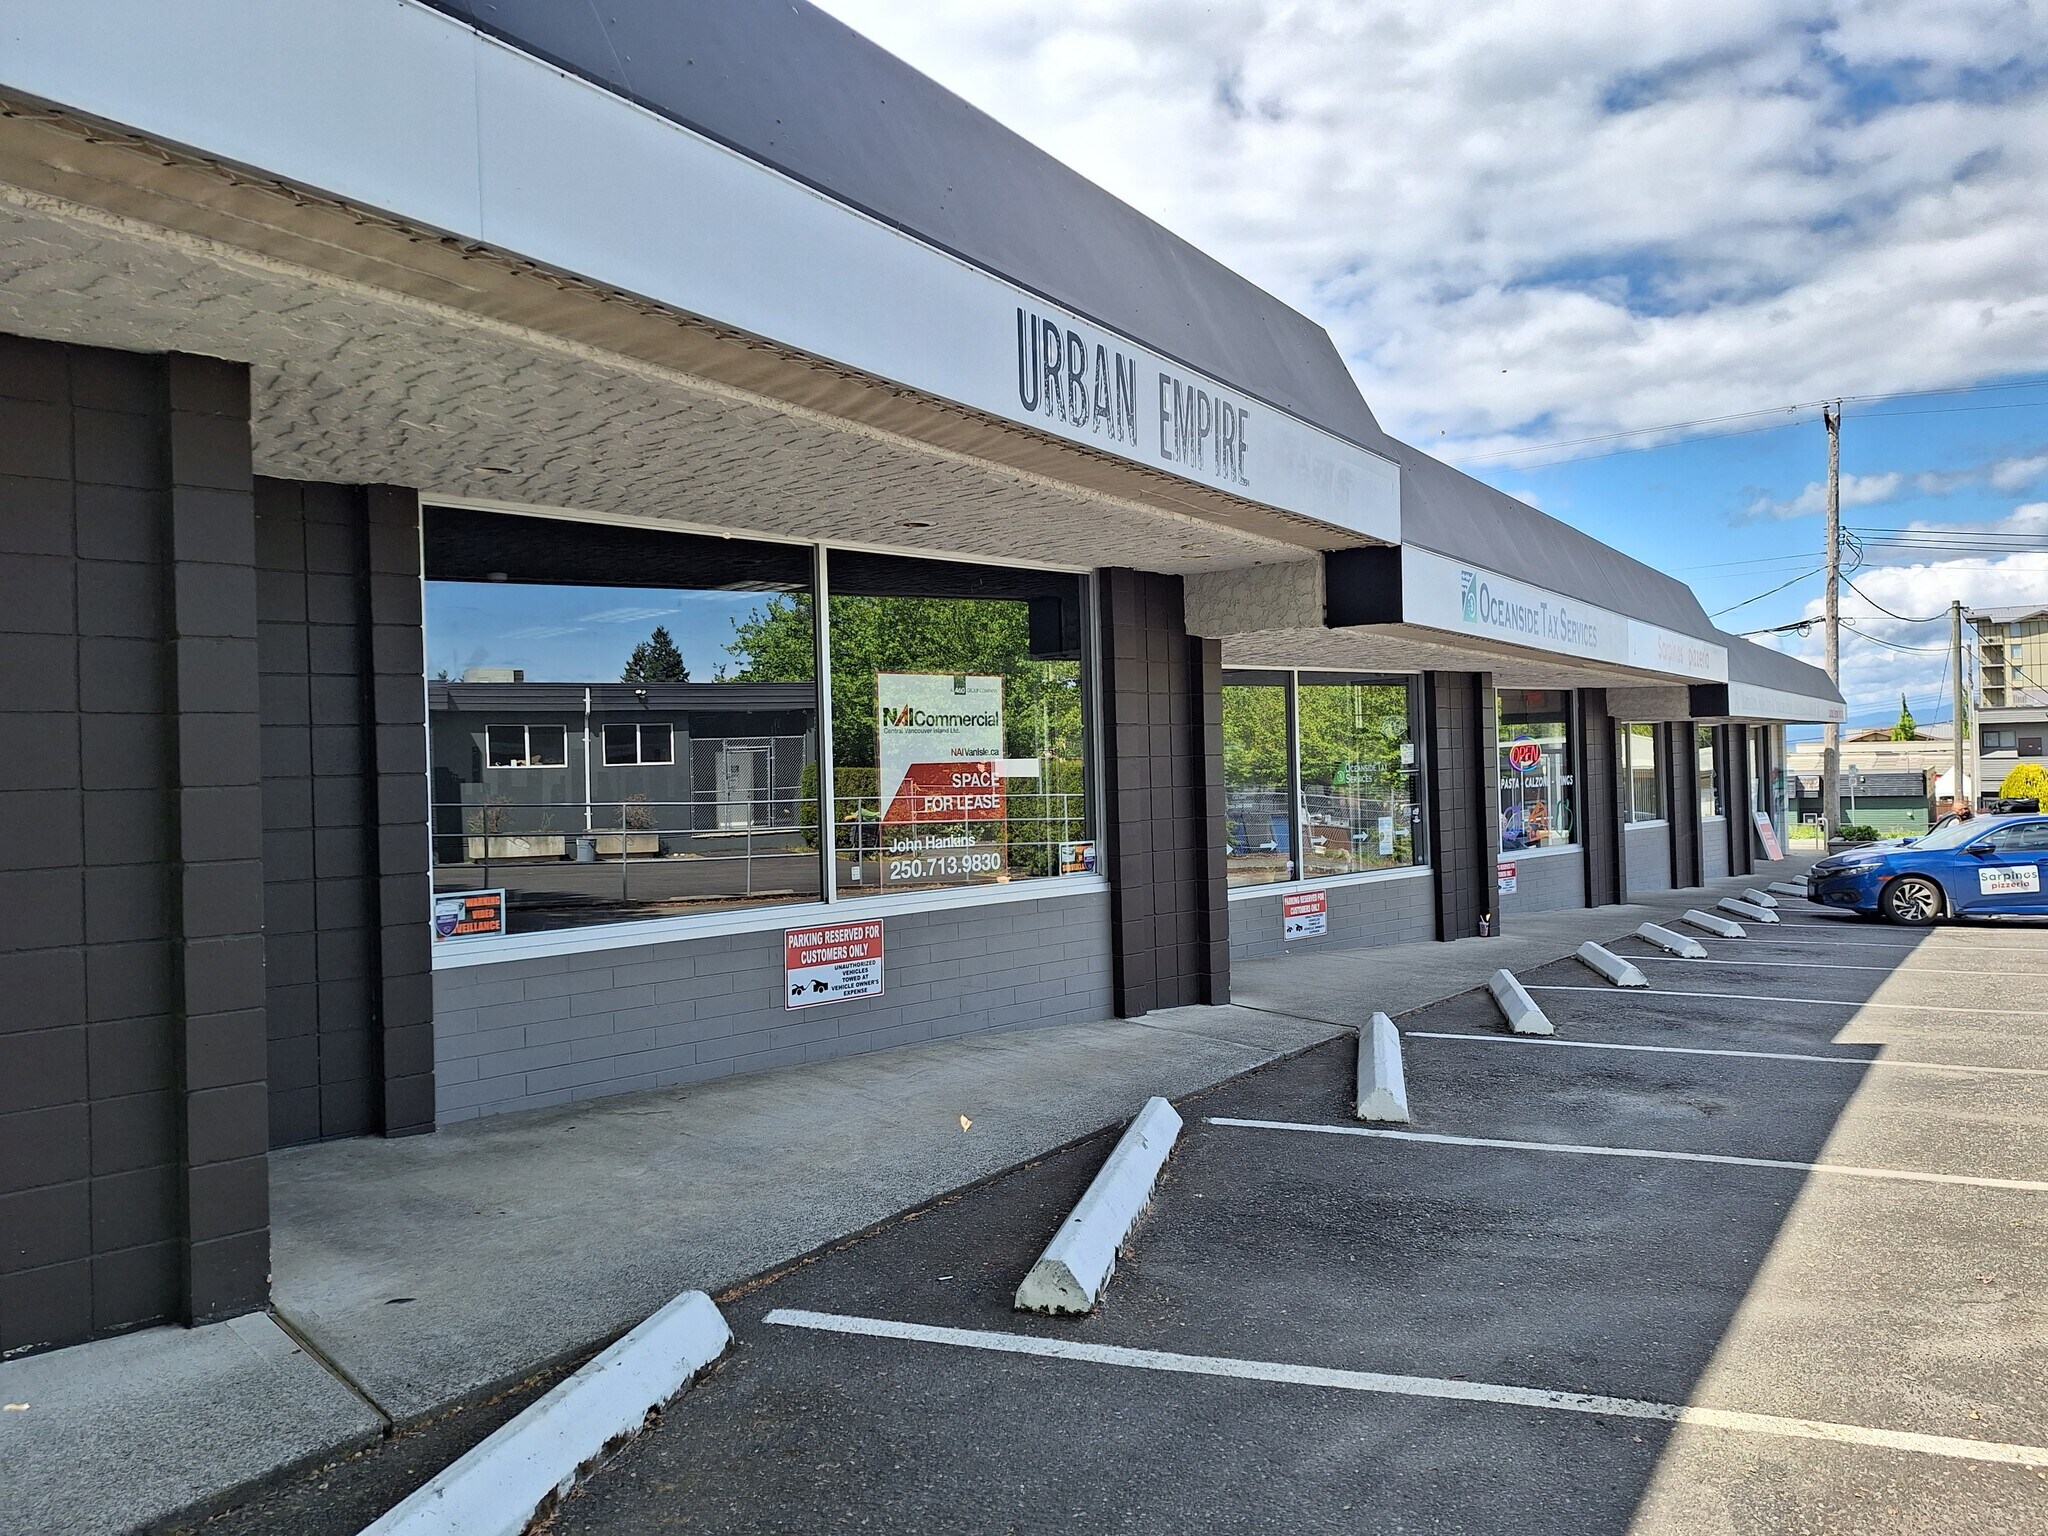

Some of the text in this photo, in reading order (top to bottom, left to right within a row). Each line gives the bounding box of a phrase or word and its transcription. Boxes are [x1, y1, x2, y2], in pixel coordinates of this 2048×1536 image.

[1017, 307, 1250, 486] URBAN EMPIRE
[1513, 745, 1539, 762] OPEN
[952, 771, 1000, 788] SPACE
[1501, 777, 1519, 789] PASTA
[925, 794, 1000, 812] FOR LEASE
[890, 834, 975, 853] John Hankins
[890, 853, 1001, 880] 250.713.9830
[1981, 871, 2037, 881] Sarpinos
[1991, 880, 2030, 890] pizzeria
[788, 925, 879, 948] PARKING RESERVED FOR
[801, 943, 869, 964] CUSTOMERS ONLY
[834, 960, 876, 970] UNAUTHORIZED
[842, 968, 868, 976] VEHICLES
[831, 979, 879, 991] VEHICLE OWNER'S
[842, 975, 861, 983] TOWED
[843, 987, 868, 996] EXPENSE
